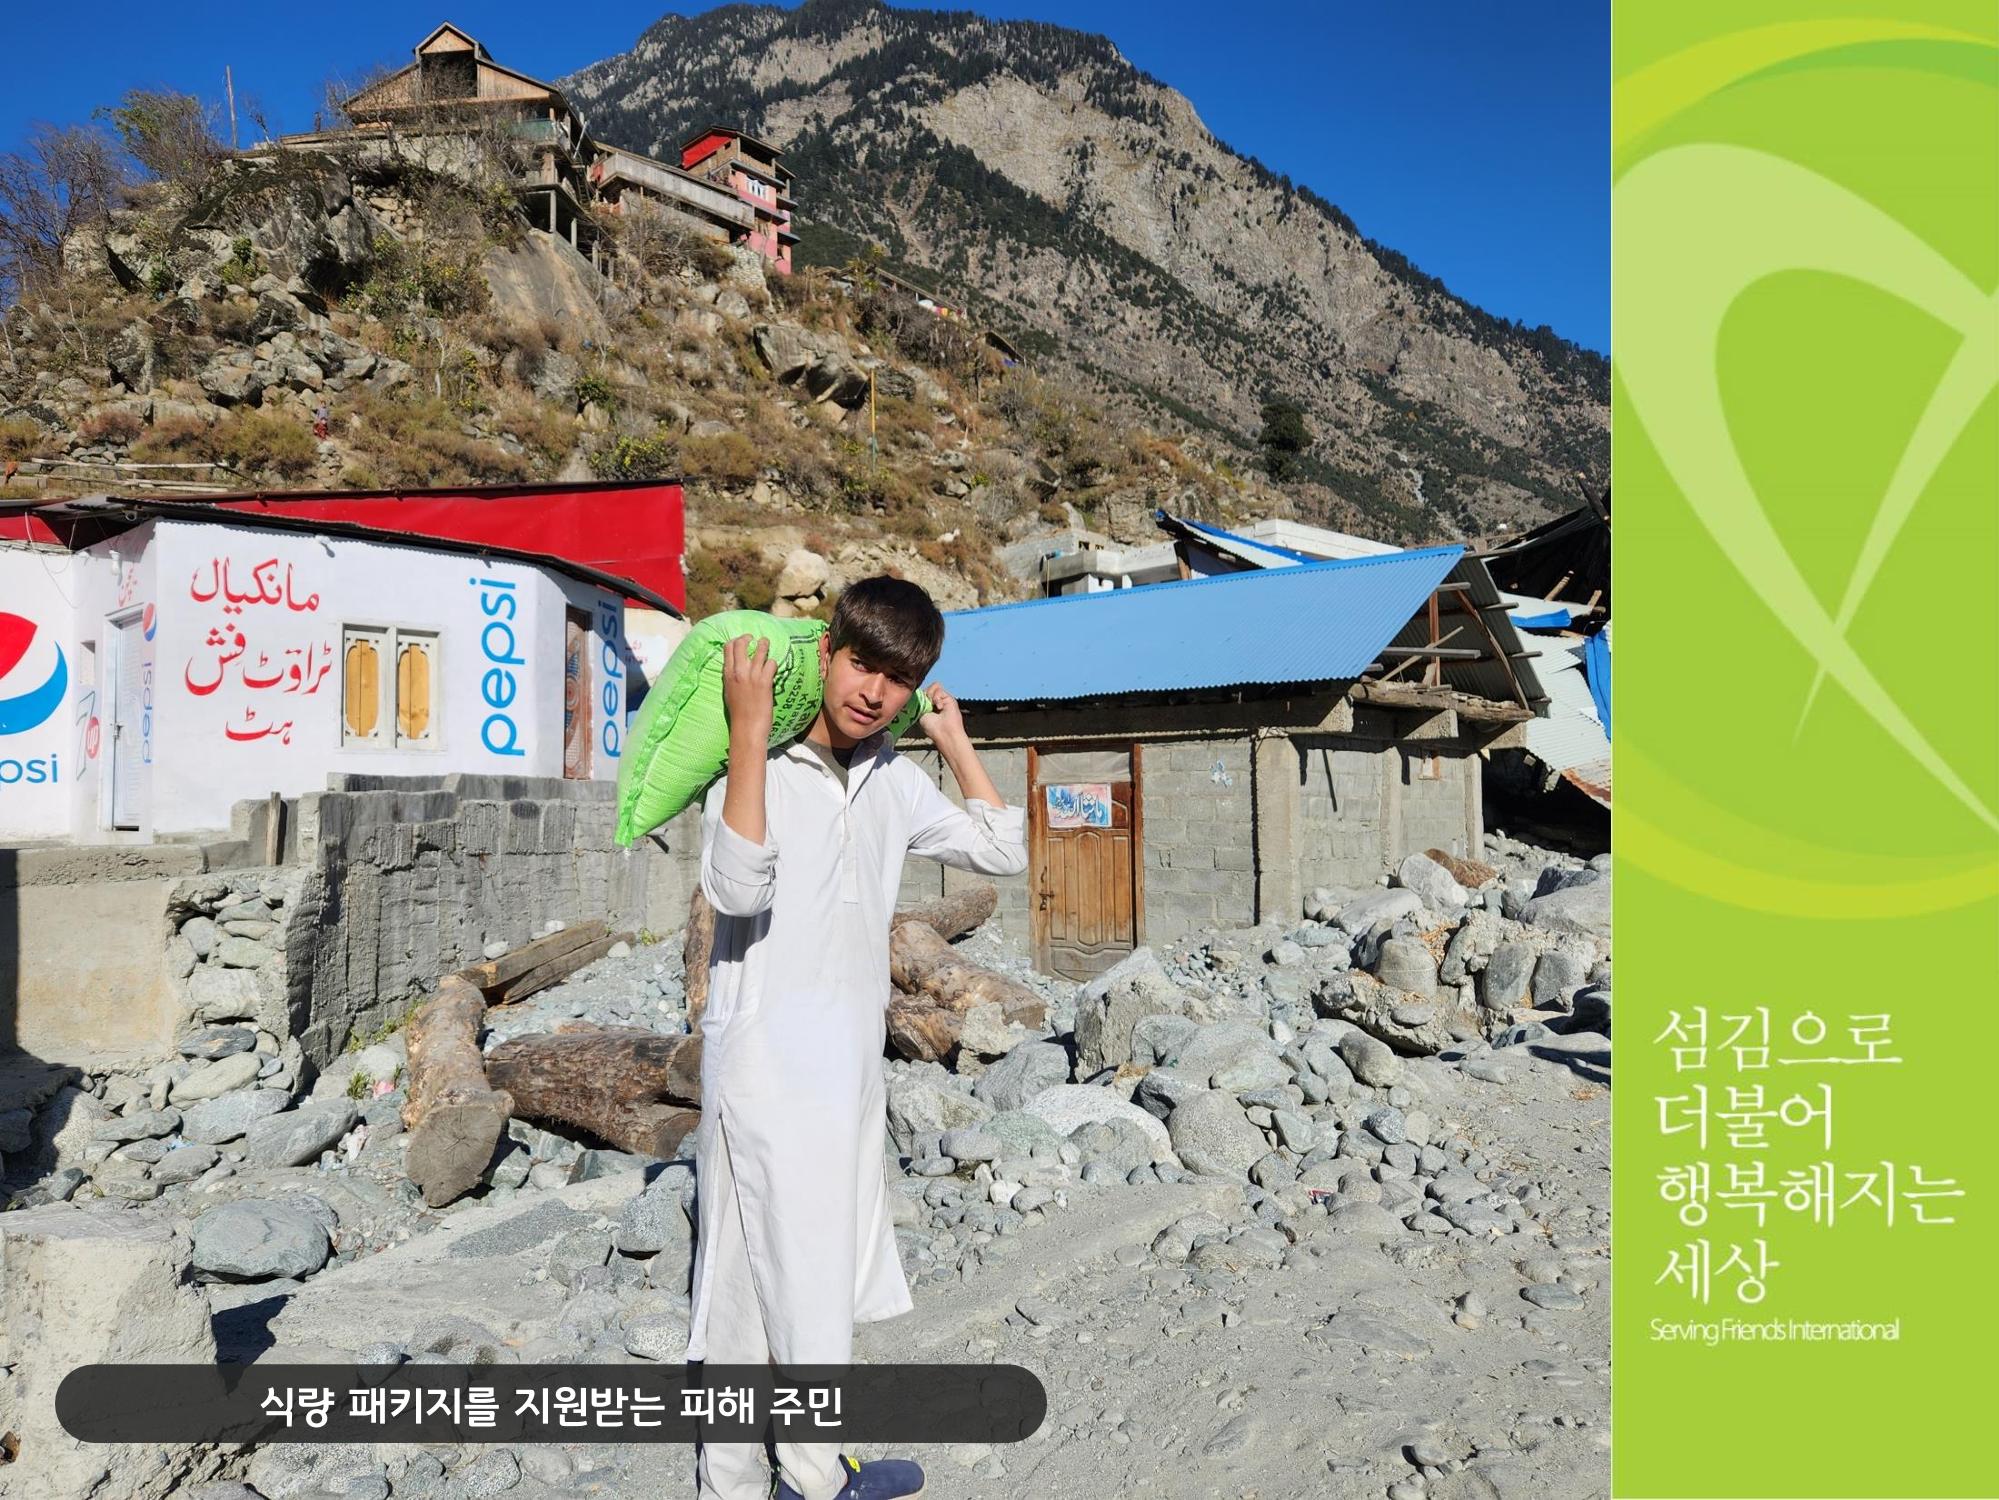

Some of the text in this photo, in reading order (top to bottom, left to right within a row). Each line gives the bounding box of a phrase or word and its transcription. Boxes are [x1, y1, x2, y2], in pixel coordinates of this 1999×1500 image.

[142, 662, 153, 764] pepsi
[468, 577, 526, 757] pepsi
[599, 600, 623, 758] pepsi
